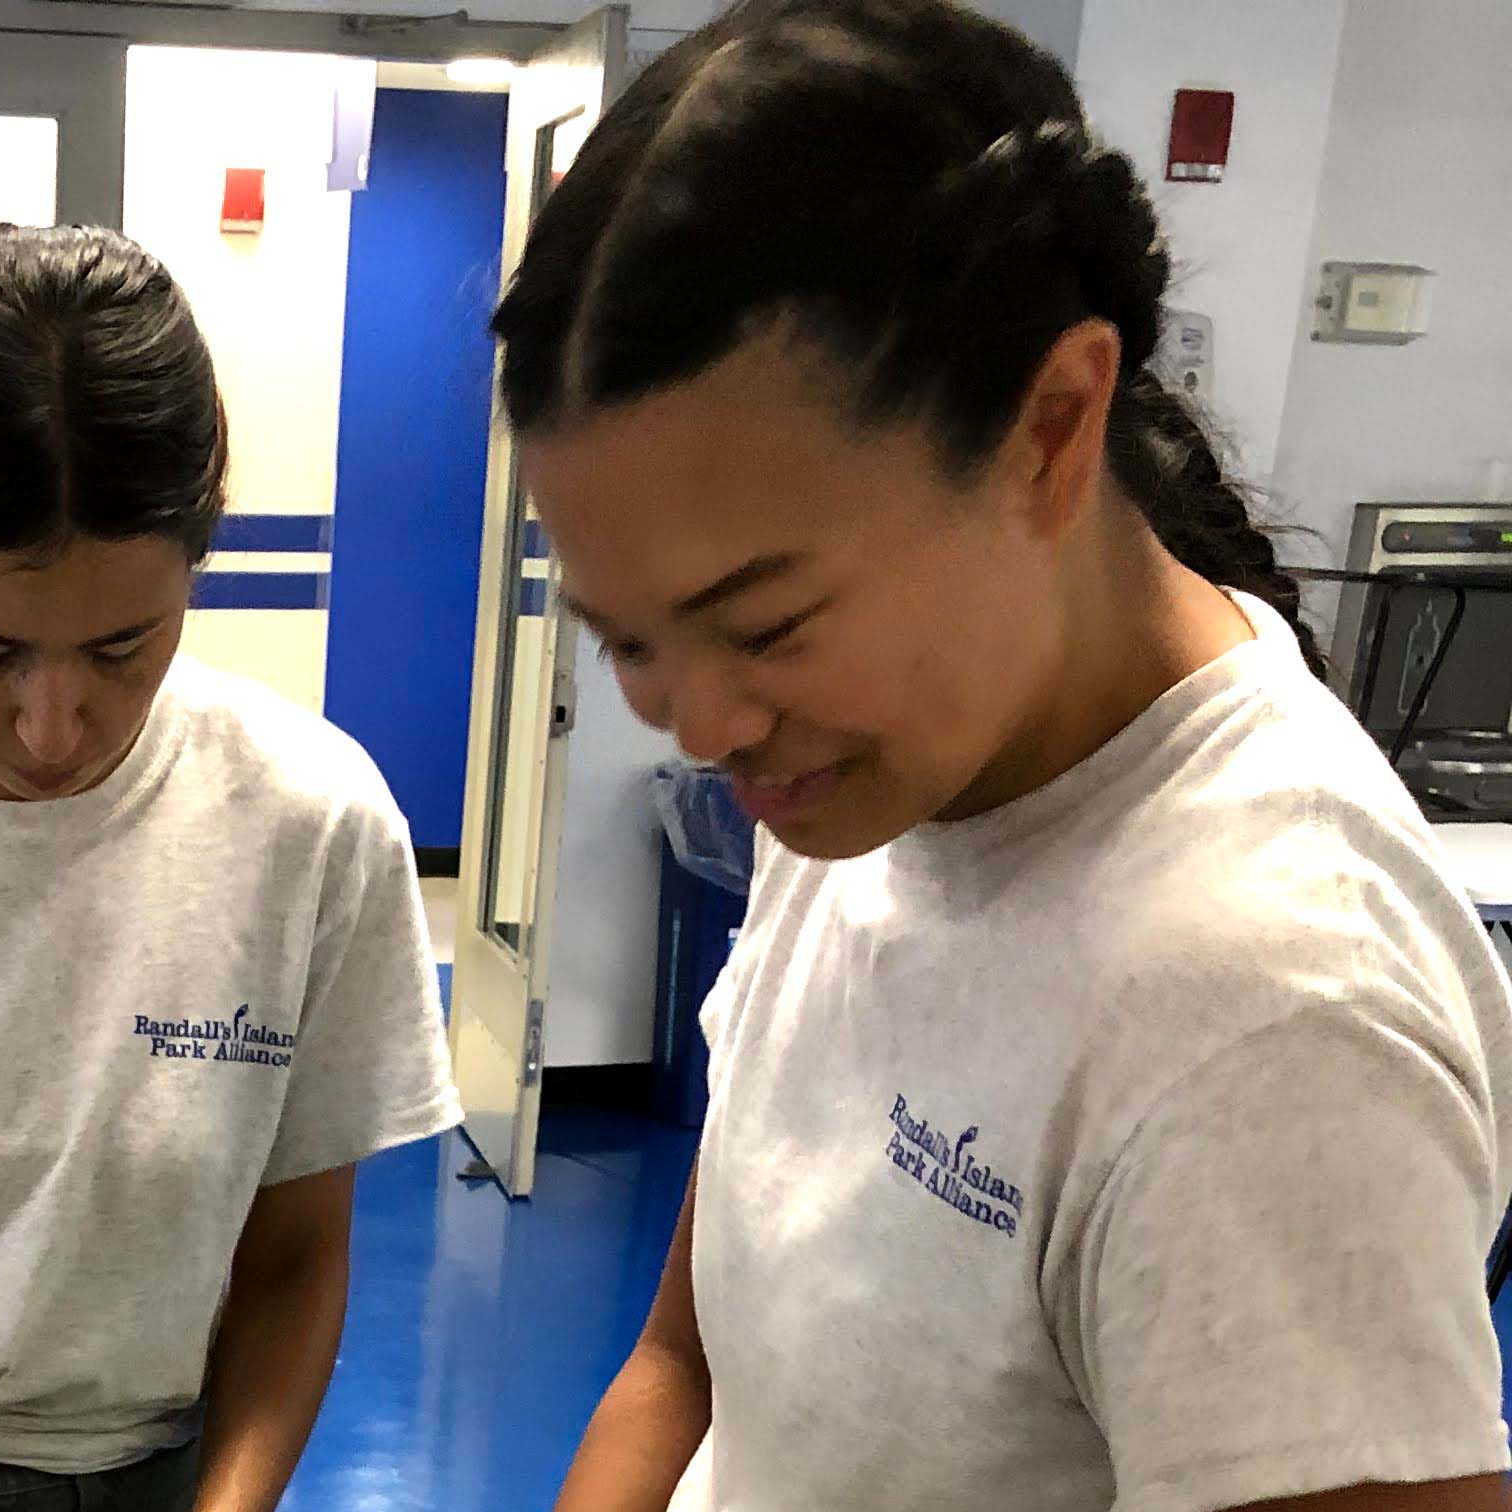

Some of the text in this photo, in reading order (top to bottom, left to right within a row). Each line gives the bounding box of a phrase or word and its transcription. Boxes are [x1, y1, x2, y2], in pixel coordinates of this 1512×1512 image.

[133, 1014, 231, 1040] Randall's
[150, 1037, 292, 1067] Park Alliance
[885, 1131, 927, 1182] Park
